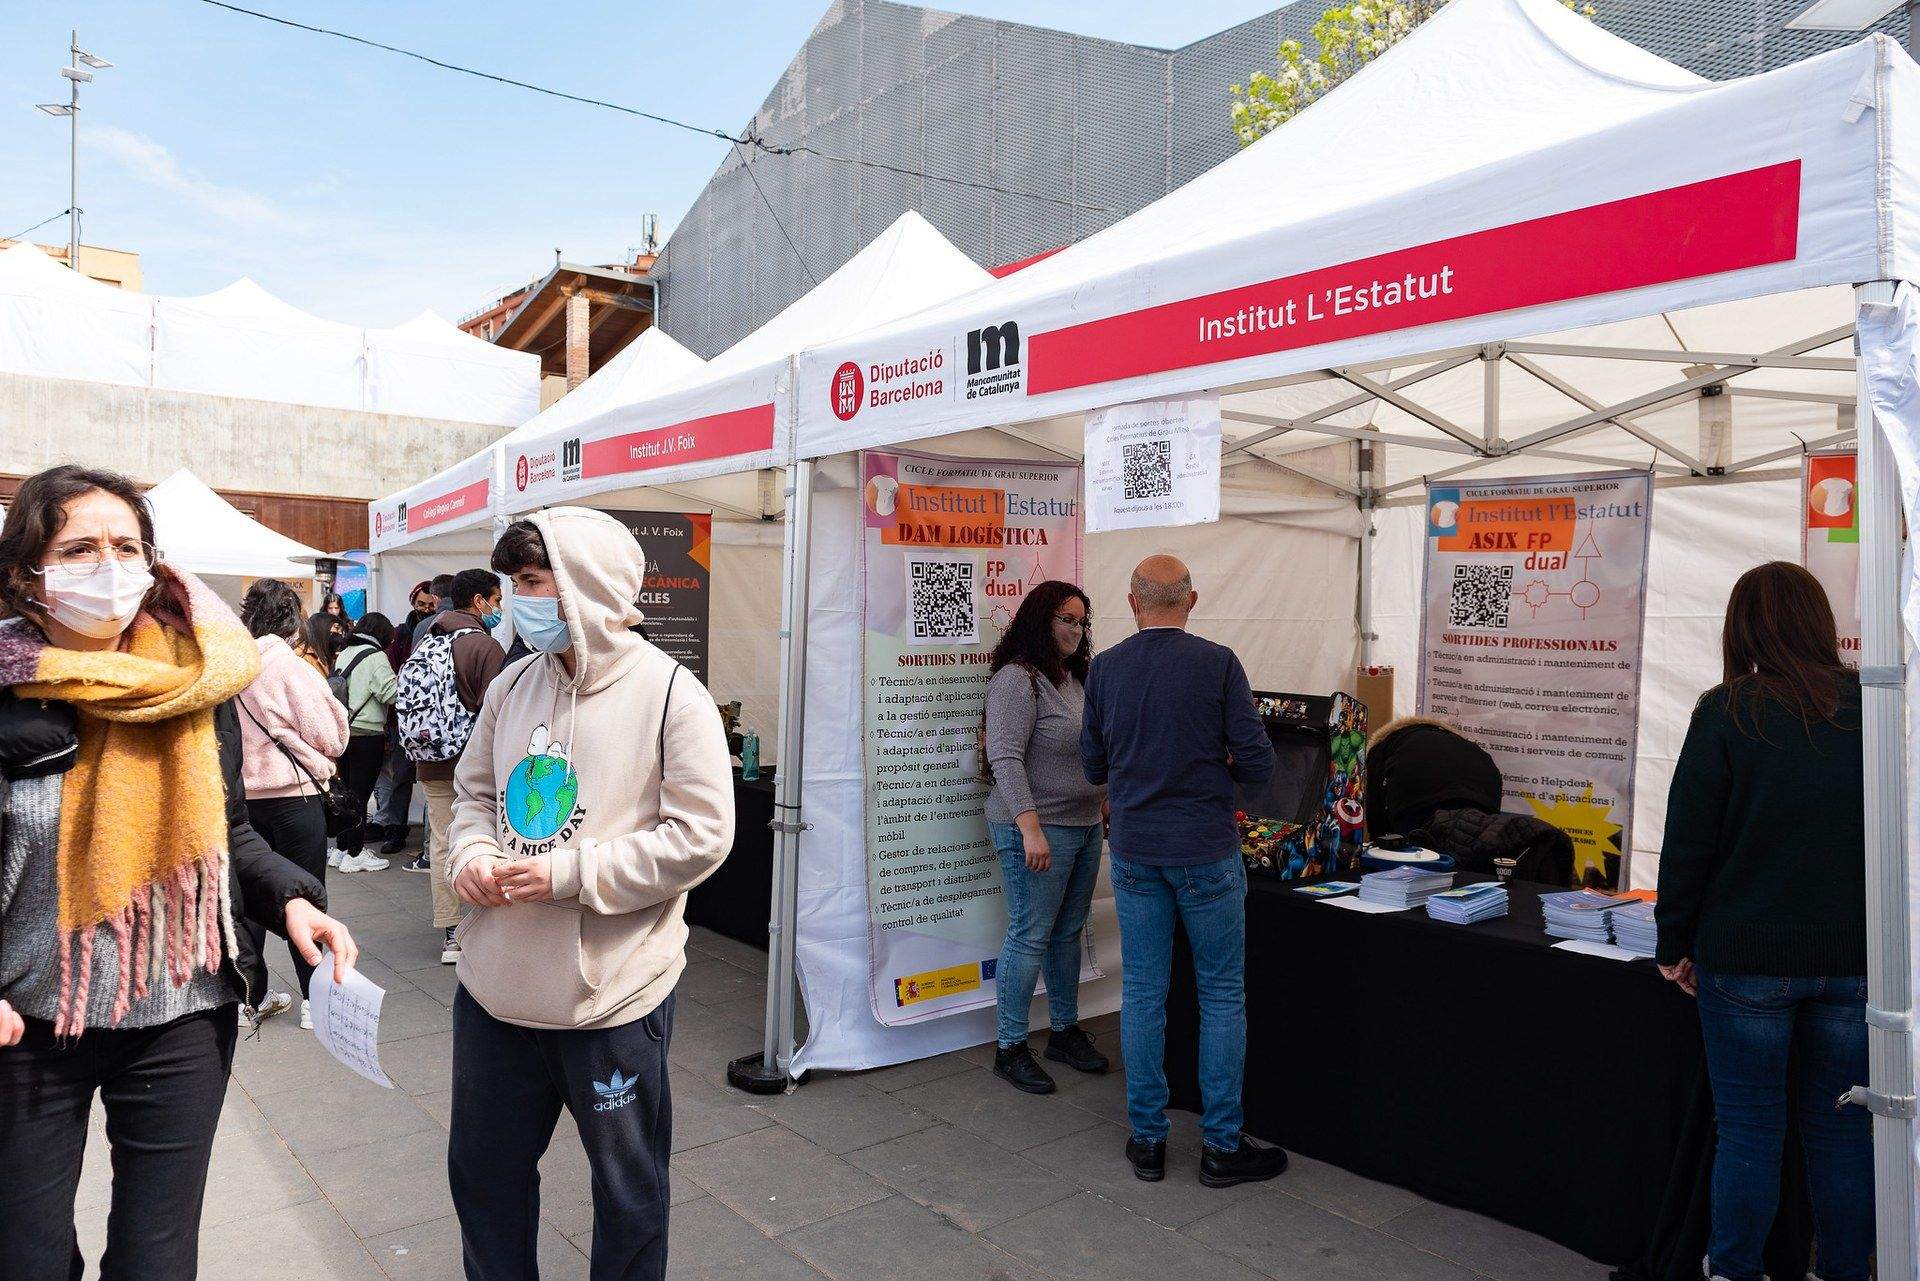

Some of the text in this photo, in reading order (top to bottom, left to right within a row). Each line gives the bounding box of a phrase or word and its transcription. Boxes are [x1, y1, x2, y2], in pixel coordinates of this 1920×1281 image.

[1199, 300, 1297, 342] Institut
[870, 349, 943, 383] Diputació
[966, 368, 1021, 388] Mancomunitat
[870, 379, 943, 408] Barcelona
[966, 380, 1020, 400] de Catalunya
[629, 442, 660, 460] Institut
[678, 434, 696, 452] Foix
[904, 464, 935, 476] CICLE
[981, 470, 993, 478] DE
[995, 470, 1018, 480] GRAU
[1019, 471, 1060, 482] SUPERIOR
[1466, 489, 1490, 497] CICLE
[1533, 487, 1545, 496] DE
[1546, 486, 1571, 495] GRAU
[1571, 482, 1619, 494] SUPERIOR
[907, 487, 987, 514] Institut
[1468, 507, 1543, 523] Institut
[664, 527, 684, 537] Foix
[898, 522, 1048, 546] DAM LOGÍSTICA
[1468, 531, 1553, 550] ASIX FP
[985, 560, 1006, 578] FP
[1524, 551, 1569, 571] dual
[985, 579, 1023, 597] dual
[1441, 633, 1618, 652] SORTIDES PROFESSIONALS
[897, 653, 956, 668] SORTIDES
[1476, 655, 1536, 667] administració
[1543, 659, 1615, 670] manteniment
[1617, 661, 1631, 671] de
[879, 676, 924, 687] Tècnic/a
[878, 690, 987, 706] i adaptació d'aplicacio
[1474, 683, 1534, 696] administració
[1542, 689, 1614, 701] manteniment
[1616, 692, 1630, 702] de
[1432, 692, 1457, 702] serveis
[1524, 703, 1558, 713] correu
[1561, 703, 1620, 717] electrònic,
[877, 713, 884, 721] a
[887, 711, 897, 721] la
[899, 709, 930, 723] gestió
[876, 728, 924, 739] Tècnic/a
[1474, 726, 1533, 740] administració
[1541, 732, 1612, 746] manteniment
[1615, 737, 1628, 747] de
[877, 746, 881, 756] i
[882, 744, 934, 757] adaptació
[1489, 743, 1520, 754] xarxes
[1527, 746, 1565, 758] serveis
[1568, 749, 1582, 758] de
[876, 759, 960, 775] propòsit general
[876, 779, 921, 791] Tècnic/a
[924, 780, 938, 788] en
[1540, 777, 1593, 789] Helpdesk
[877, 798, 881, 808] i
[882, 795, 933, 808] adaptació
[914, 812, 928, 822] de
[507, 837, 517, 851] A
[520, 839, 557, 856] NICE
[559, 803, 587, 842] DAY
[878, 830, 906, 843] mòbil
[879, 837, 991, 861] Gestor de relacions amb
[879, 867, 892, 878] de
[893, 863, 937, 876] compres,
[939, 859, 952, 870] de
[880, 869, 991, 895] de transport i distribució
[880, 885, 1002, 914] Tècnic/a de desplegament
[882, 907, 964, 930] control de qualitat
[593, 1093, 637, 1112] adidas
